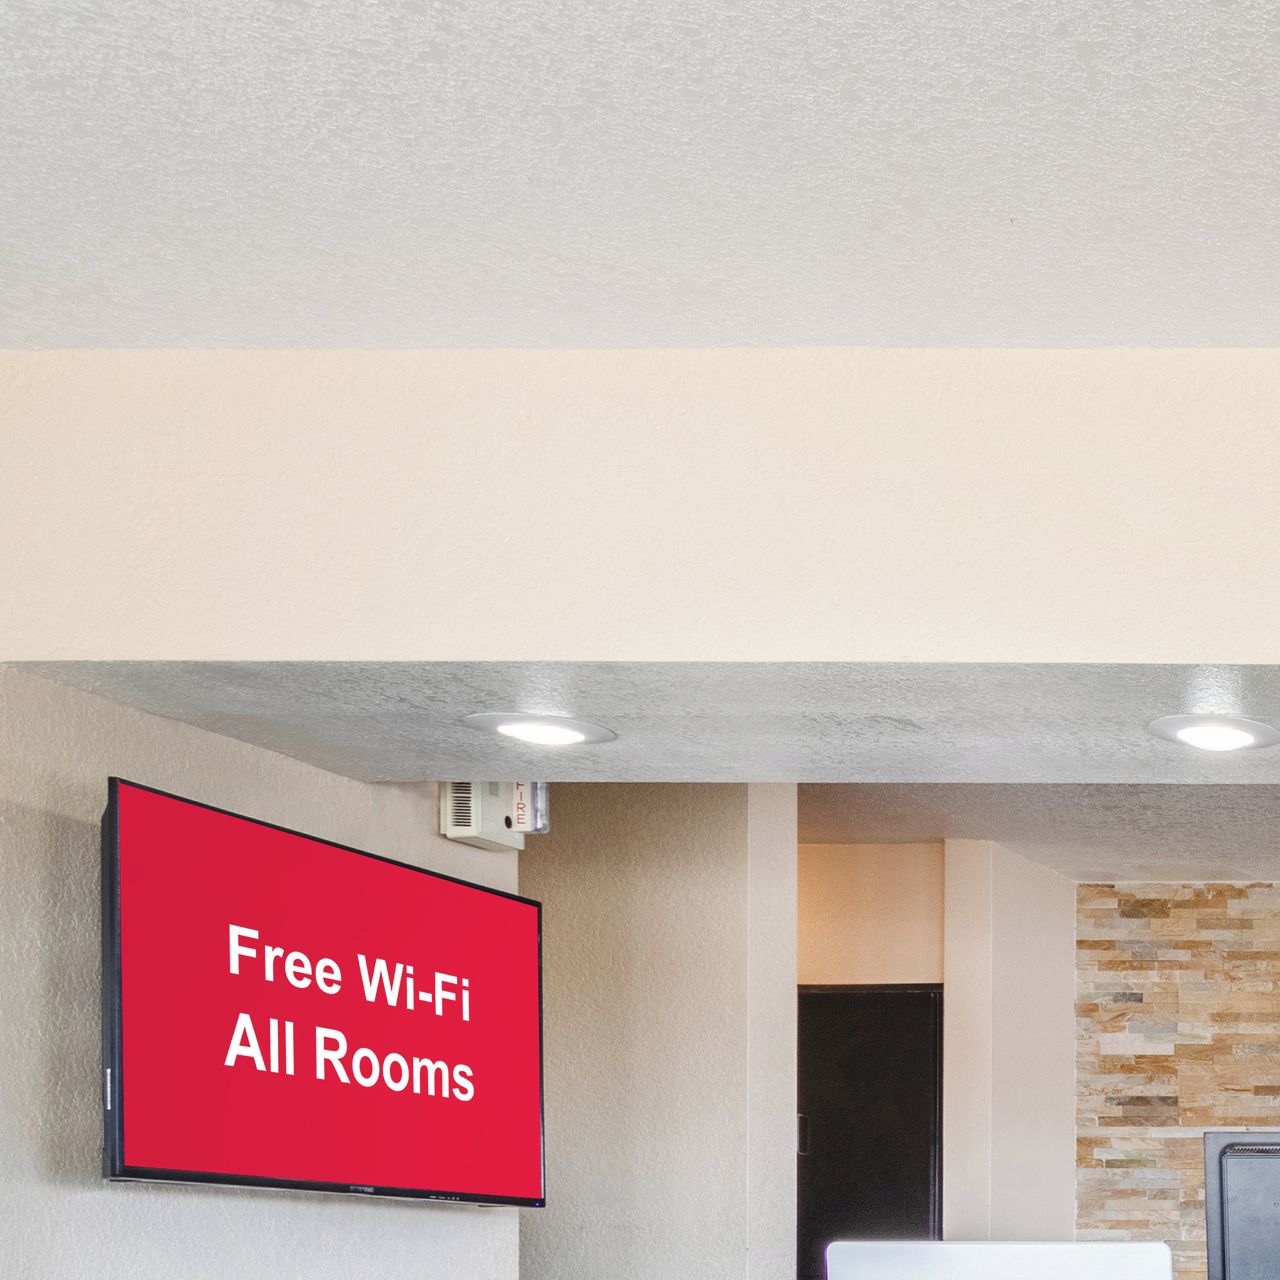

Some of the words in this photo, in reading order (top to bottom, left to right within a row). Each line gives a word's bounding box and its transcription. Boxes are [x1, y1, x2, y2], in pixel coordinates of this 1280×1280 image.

[228, 923, 342, 995] Free
[356, 953, 470, 1022] Wi-Fi
[223, 1012, 295, 1076] All
[315, 1026, 475, 1102] Rooms
